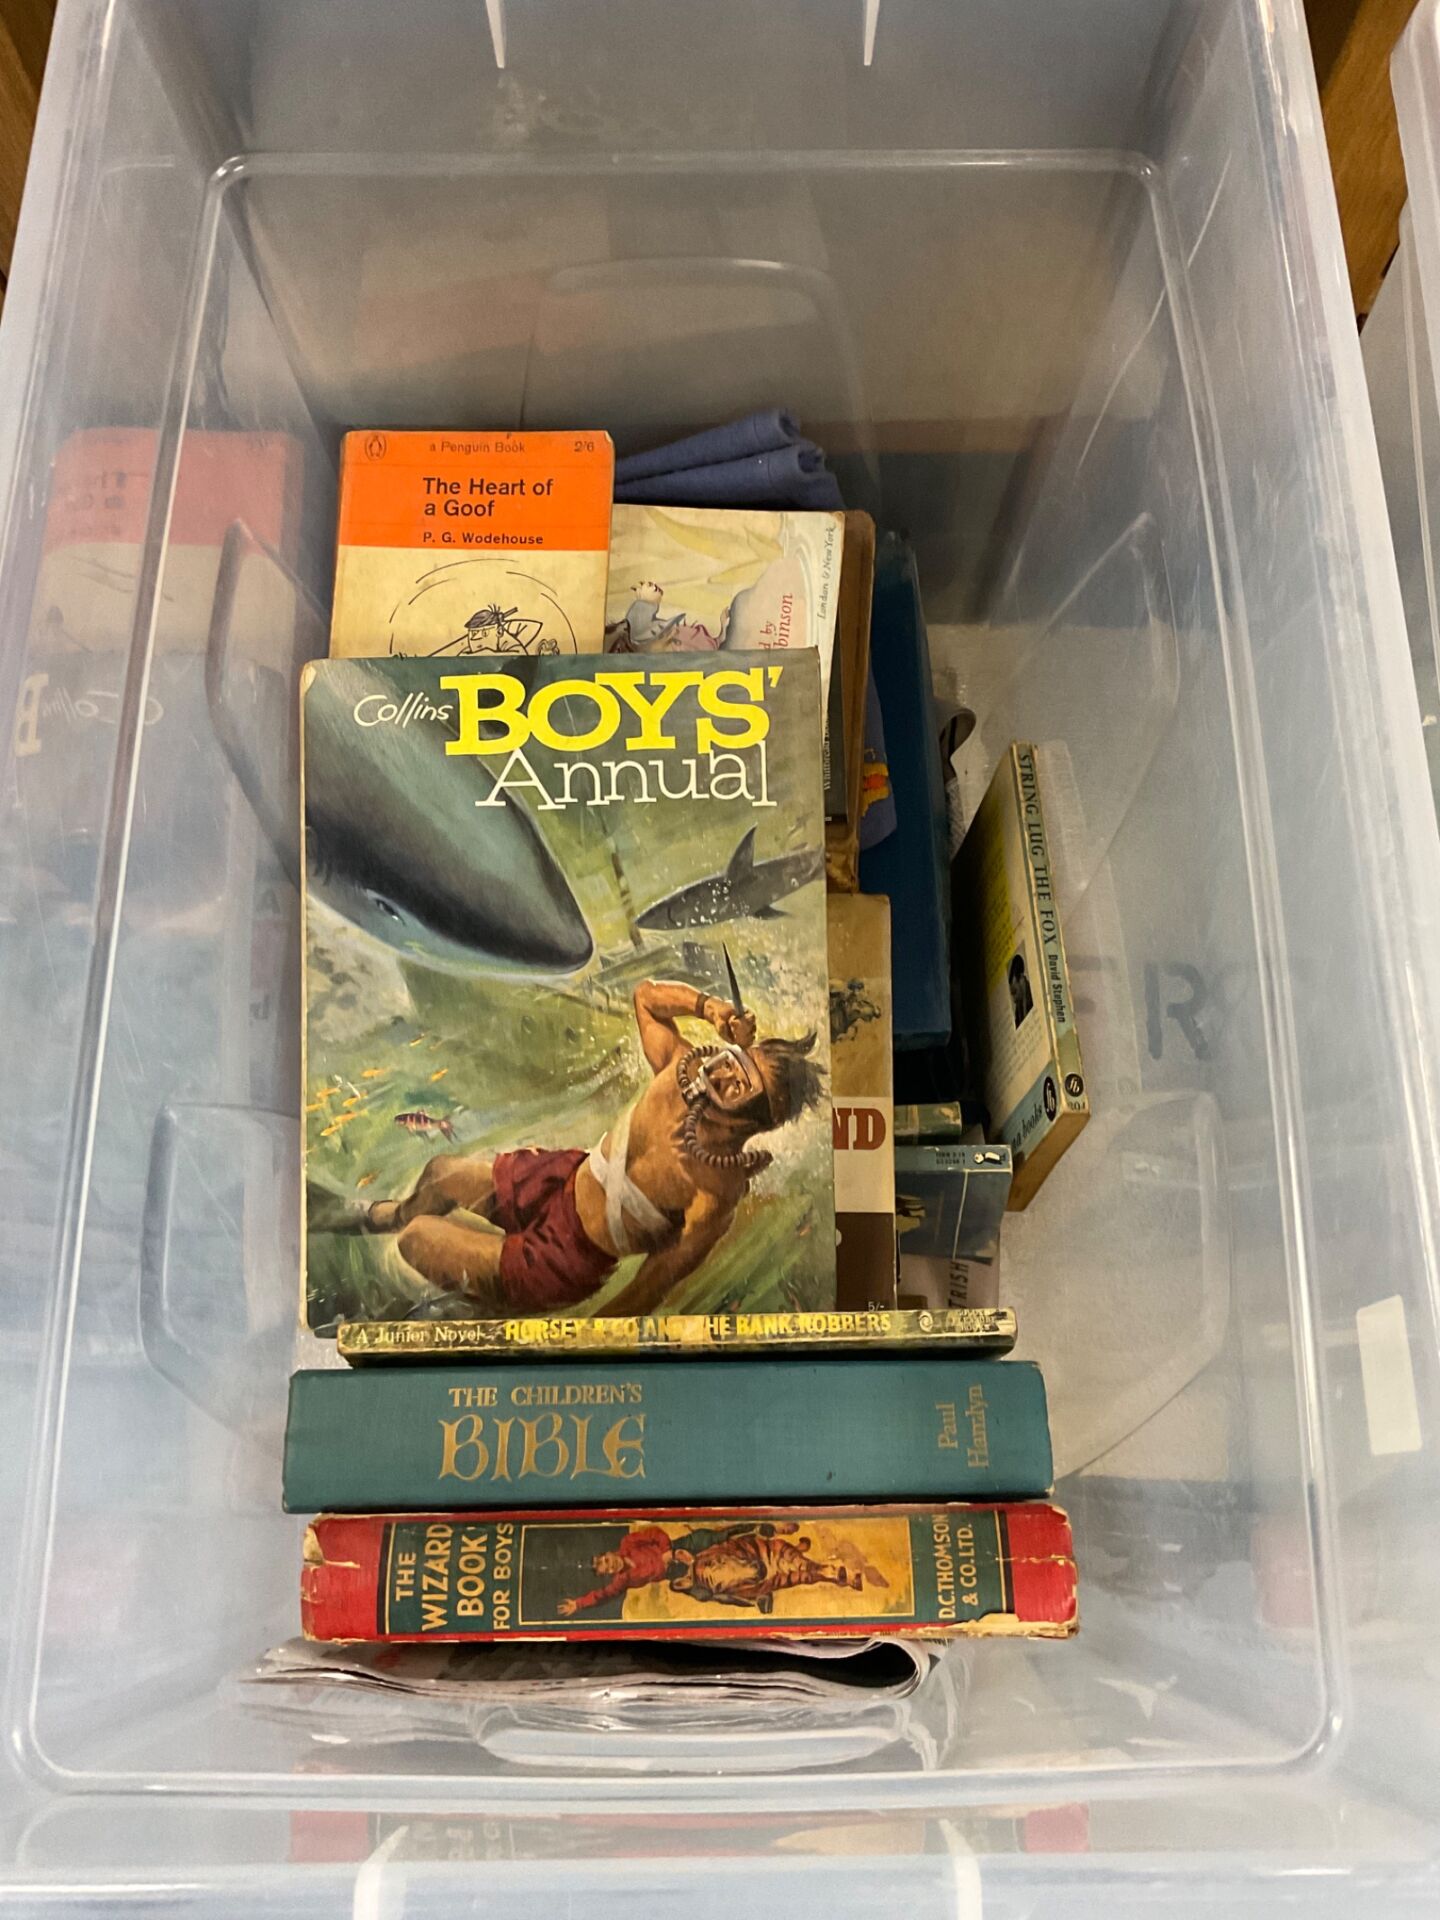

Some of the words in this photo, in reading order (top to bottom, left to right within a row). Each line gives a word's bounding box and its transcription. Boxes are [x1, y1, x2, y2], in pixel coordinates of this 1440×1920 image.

[429, 443, 436, 452] a
[441, 441, 490, 455] Penguin
[495, 441, 526, 453] Book
[423, 477, 461, 495] The
[469, 478, 526, 496] Heart
[532, 478, 554, 496] of
[424, 503, 436, 516] a
[443, 499, 495, 517] Goof
[423, 532, 436, 543] P.
[441, 531, 456, 543] G.
[462, 532, 544, 545] Wodehouse
[353, 691, 453, 728] Collins
[475, 739, 778, 811] Annual
[1019, 753, 1039, 816] STRING
[1027, 823, 1045, 856] LUG
[1034, 864, 1051, 901] THE
[1040, 910, 1058, 945] FOX
[1048, 954, 1061, 981] David
[1052, 983, 1066, 1023] Stephen
[356, 1329, 367, 1344] A
[374, 1328, 427, 1345] Junior
[434, 1325, 481, 1345] Novel
[736, 1314, 795, 1337] BANK
[798, 1312, 891, 1335] ROBBERS
[449, 1386, 498, 1408] THE
[511, 1382, 642, 1407] CHILDREN'S
[936, 1402, 959, 1449] Paul
[965, 1383, 990, 1469] Hamlyn
[438, 1412, 646, 1483] BIBLE
[493, 1522, 514, 1589] BOYS
[395, 1551, 417, 1602] THE
[421, 1522, 453, 1632] WIZARD
[456, 1533, 489, 1618] BOOK
[493, 1595, 511, 1631] FOR
[962, 1591, 978, 1606] &
